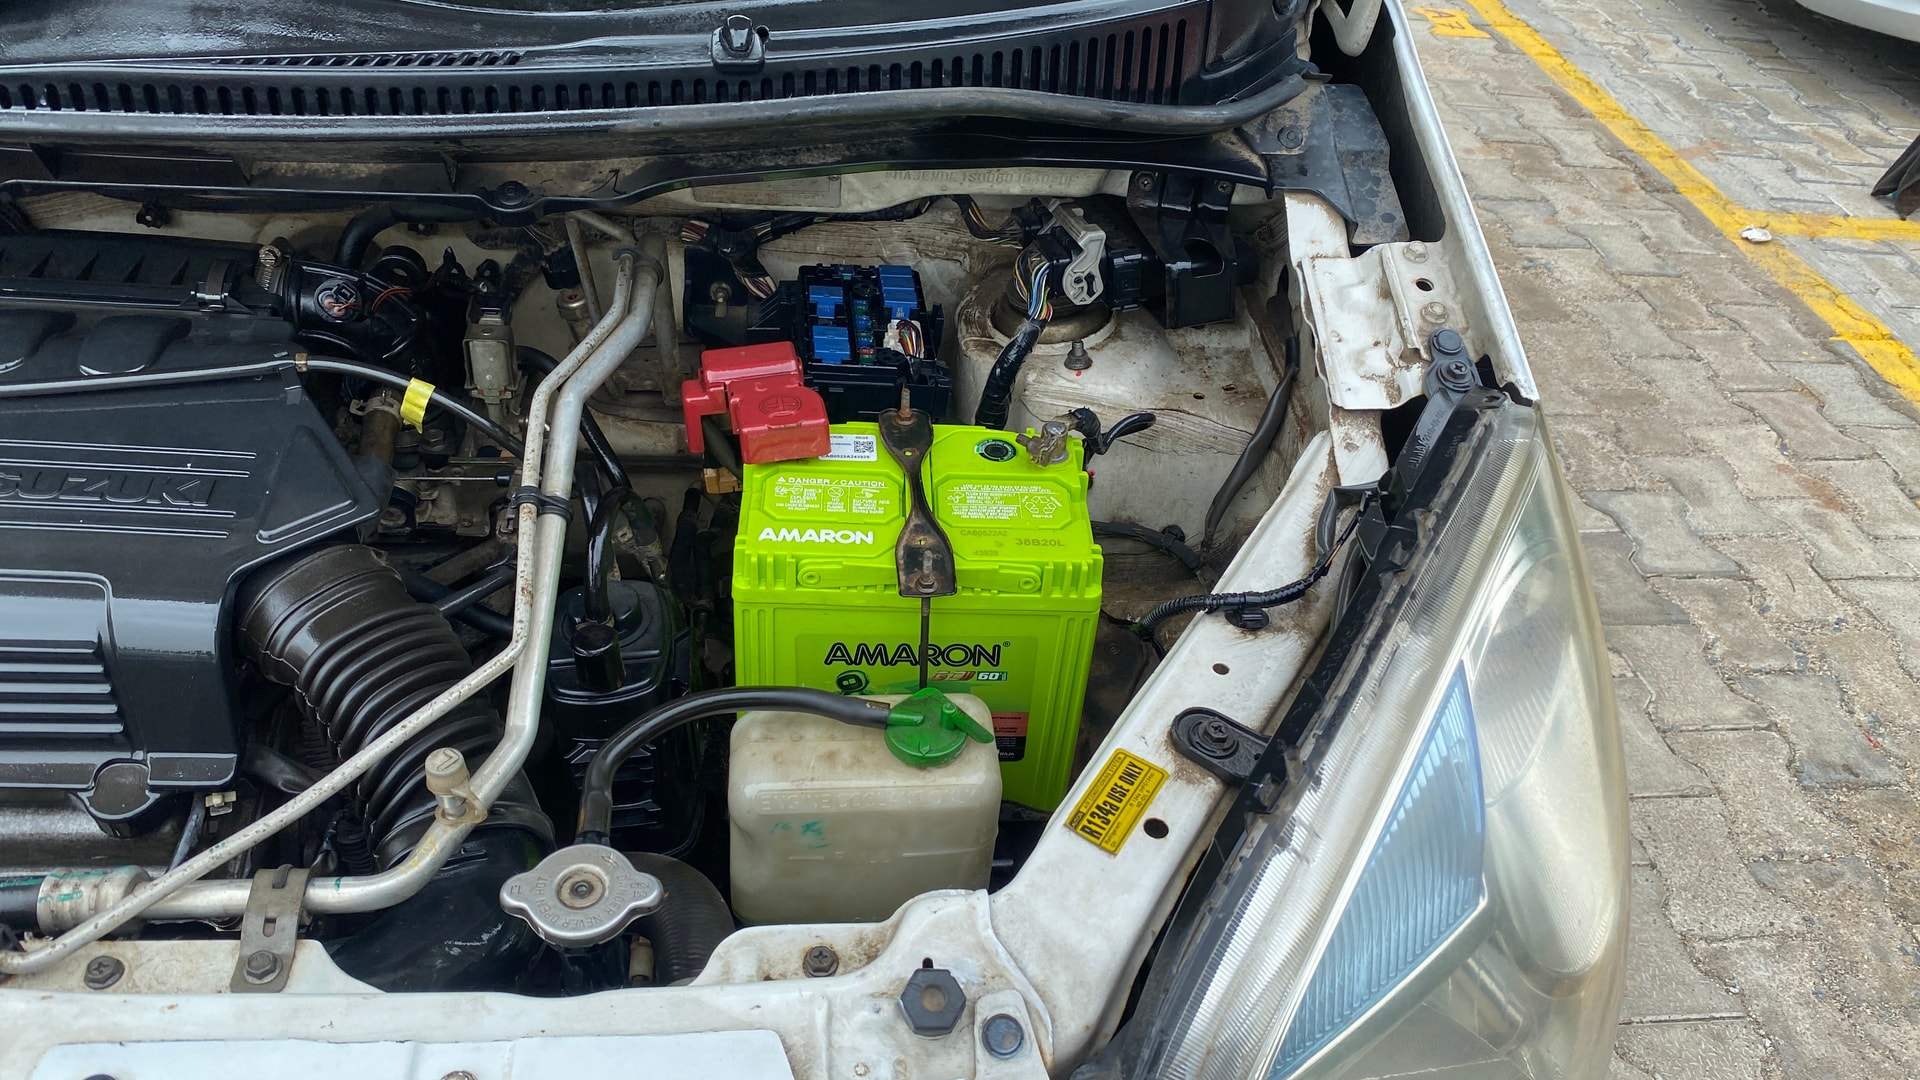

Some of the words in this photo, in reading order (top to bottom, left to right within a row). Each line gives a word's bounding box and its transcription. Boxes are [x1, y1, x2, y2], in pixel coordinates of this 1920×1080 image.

[788, 477, 830, 485] DANGER
[840, 479, 885, 487] CAUTION
[758, 527, 874, 545] AMARON
[1015, 538, 1065, 547] 38B20L
[824, 642, 1001, 667] AMARON
[1080, 799, 1121, 840] R134a
[1106, 782, 1130, 804] USE
[1118, 760, 1144, 786] ONLY
[536, 899, 560, 923] OPEN
[561, 914, 602, 929] NEVER
